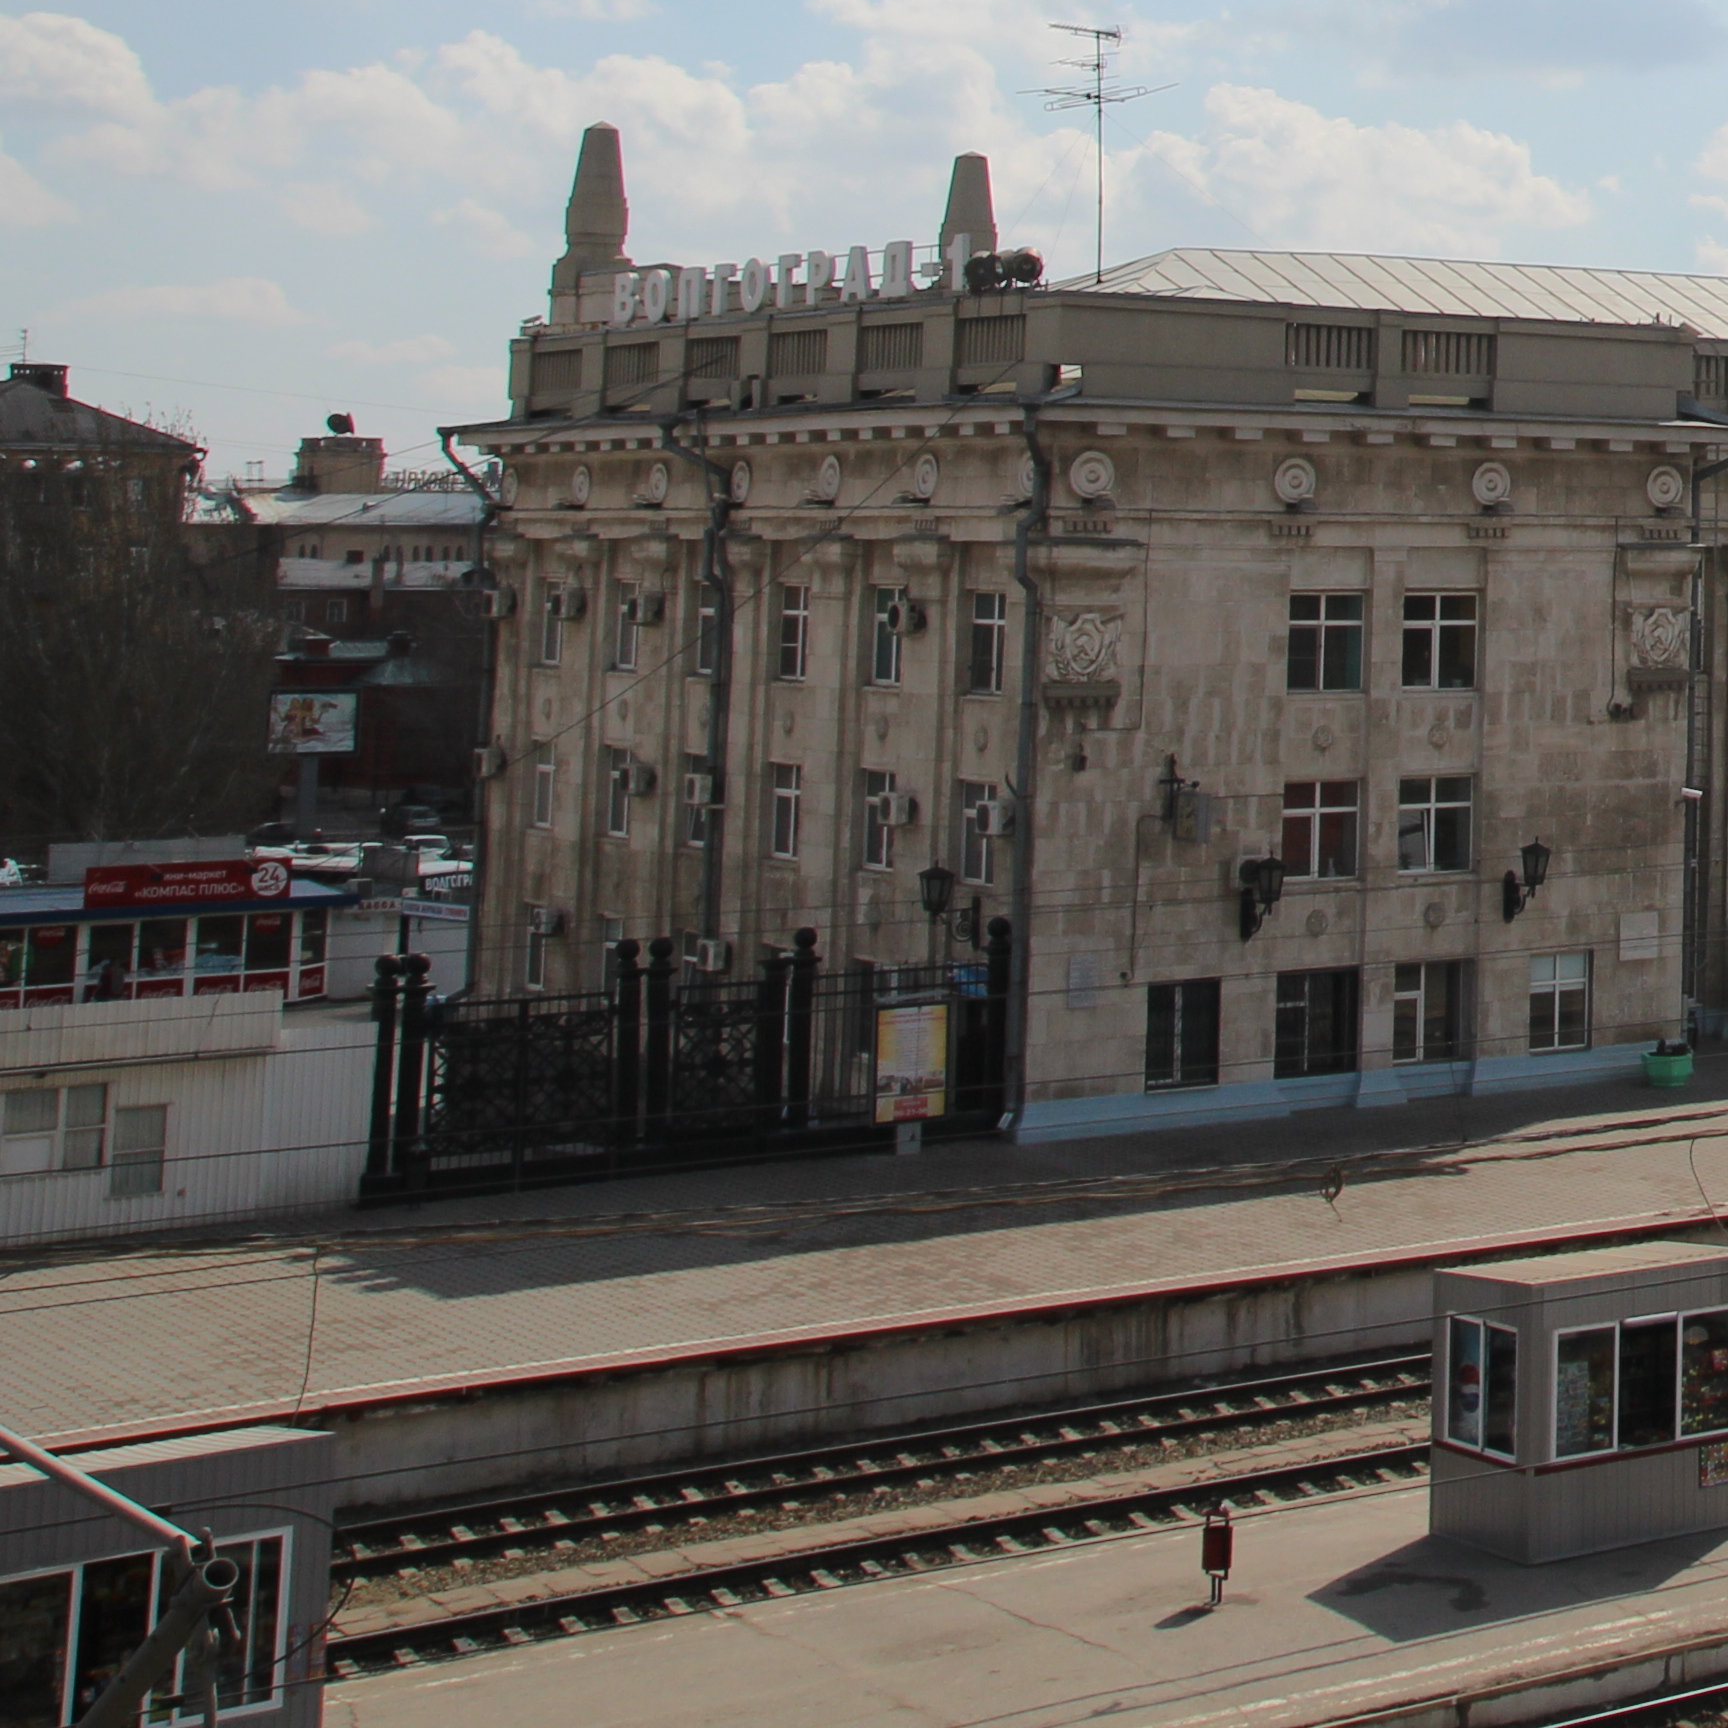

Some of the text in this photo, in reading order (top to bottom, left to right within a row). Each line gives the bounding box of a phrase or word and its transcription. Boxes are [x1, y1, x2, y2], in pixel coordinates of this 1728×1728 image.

[612, 233, 971, 324] ВОЛГОГРАД-1
[162, 870, 227, 881] ини-маркет
[258, 866, 281, 883] 24
[134, 882, 246, 898] «КОМПАС ПЛЮС»
